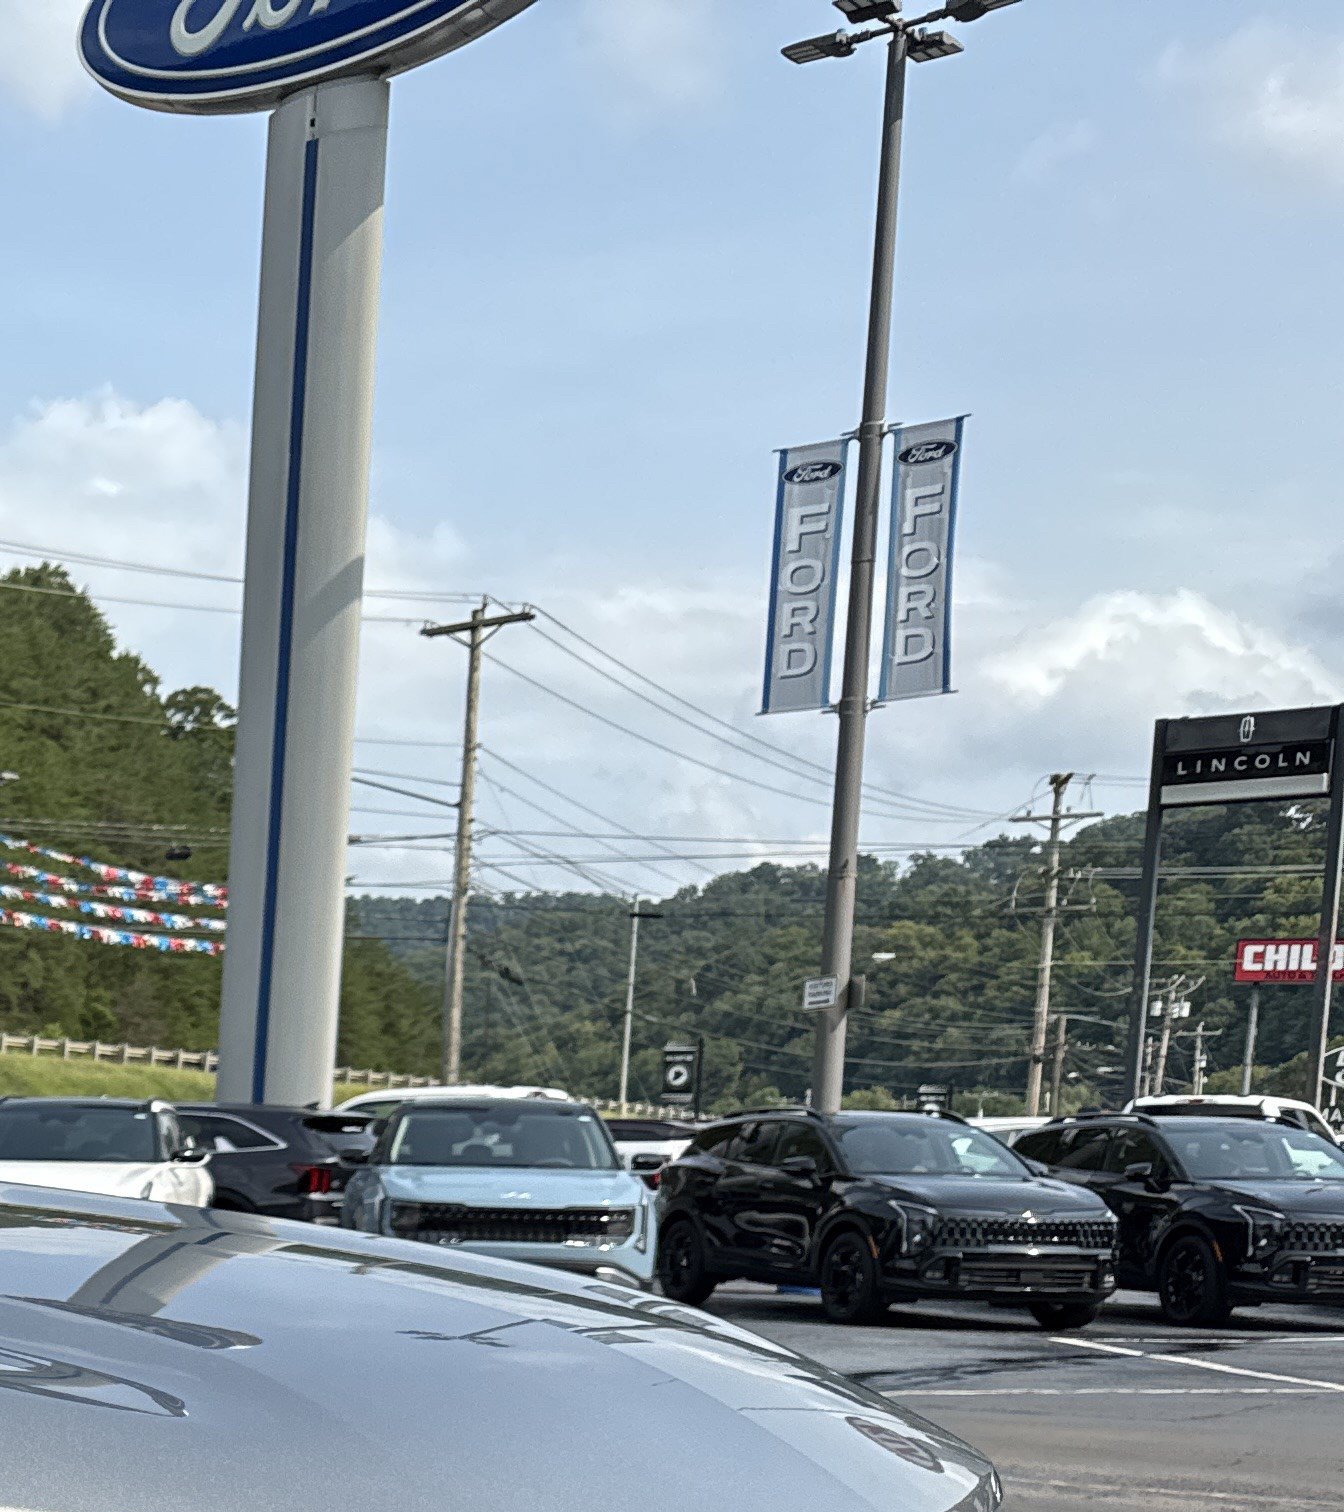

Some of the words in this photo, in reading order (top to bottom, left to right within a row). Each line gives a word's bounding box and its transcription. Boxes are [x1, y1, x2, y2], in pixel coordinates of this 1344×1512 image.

[778, 502, 830, 680] FORD
[894, 483, 945, 667] FORD
[1176, 750, 1311, 776] LINCOLN
